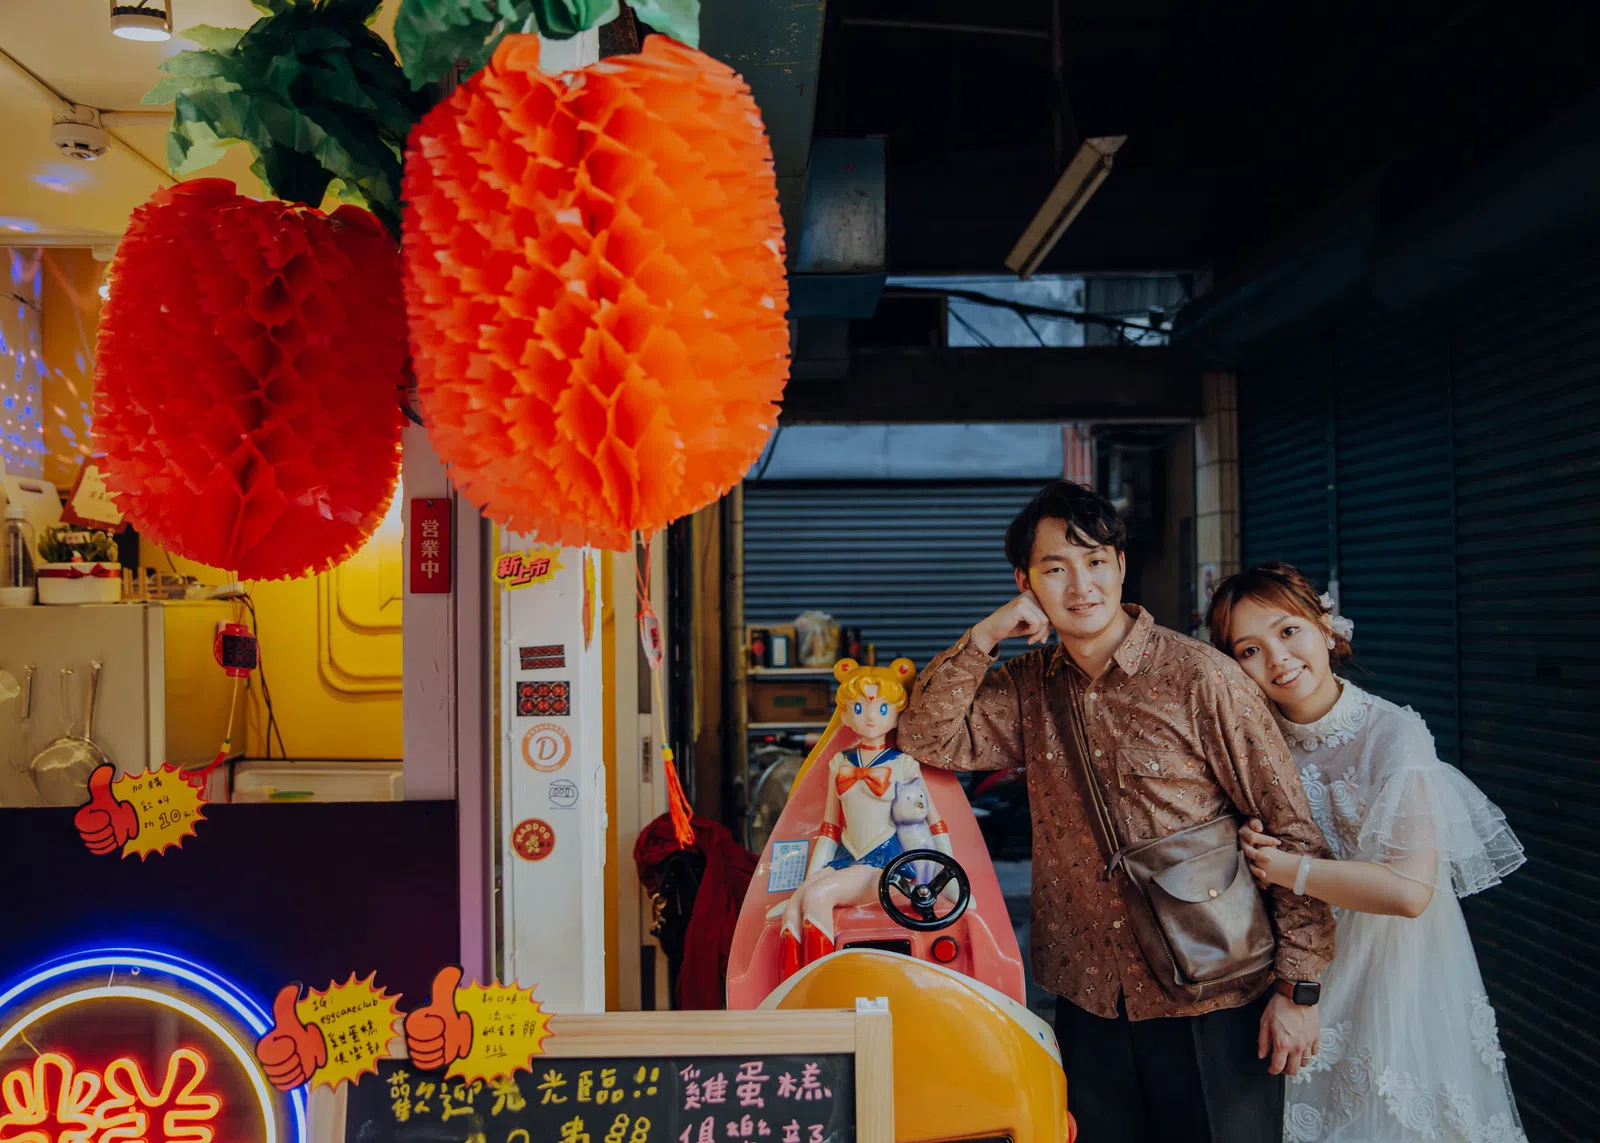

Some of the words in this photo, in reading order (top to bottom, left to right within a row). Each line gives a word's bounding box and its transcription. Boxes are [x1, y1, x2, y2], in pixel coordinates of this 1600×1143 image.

[497, 555, 550, 586] 新上市
[320, 998, 379, 1024] eggcakeclub
